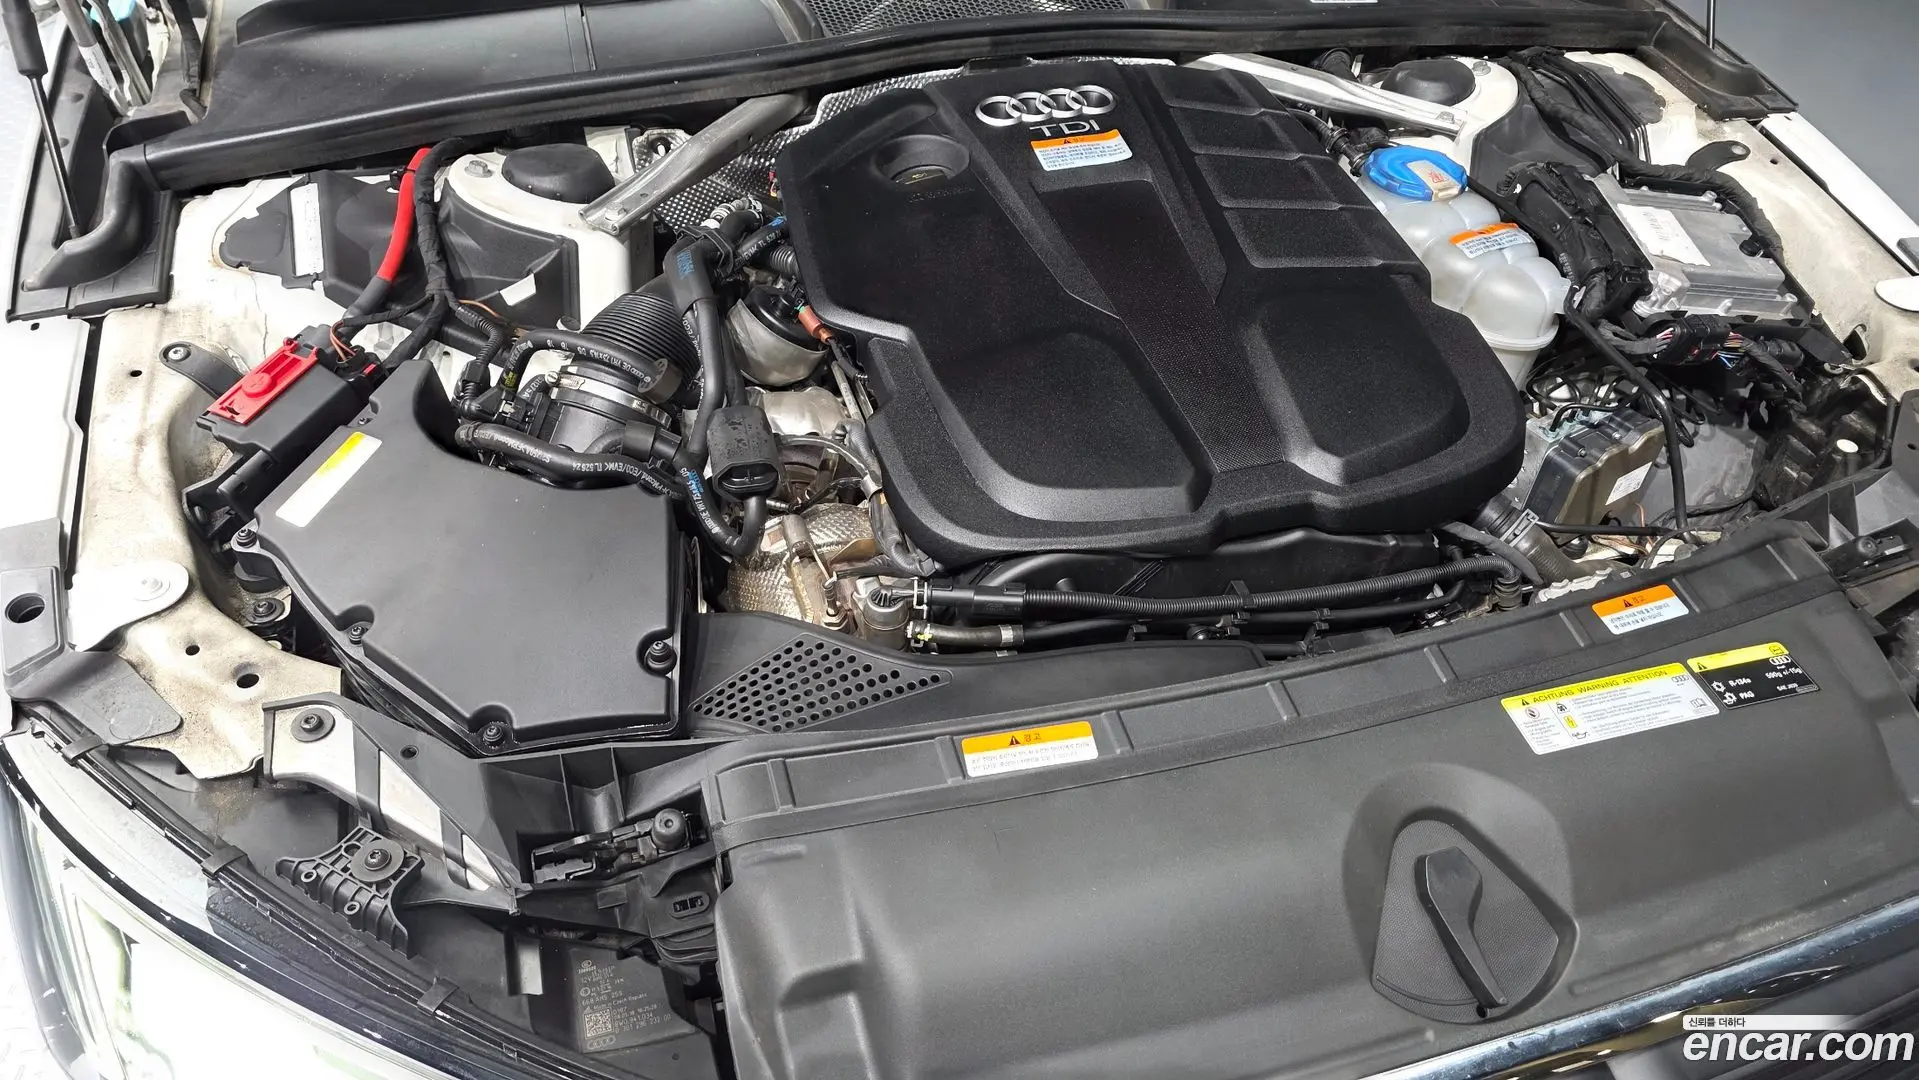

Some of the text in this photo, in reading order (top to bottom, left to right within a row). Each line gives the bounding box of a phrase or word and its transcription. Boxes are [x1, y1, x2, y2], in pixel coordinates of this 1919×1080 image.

[1029, 119, 1100, 137] TDI
[1533, 671, 1668, 703] ACHTUNG WARNING ATTENTION
[1023, 733, 1042, 743] 경고
